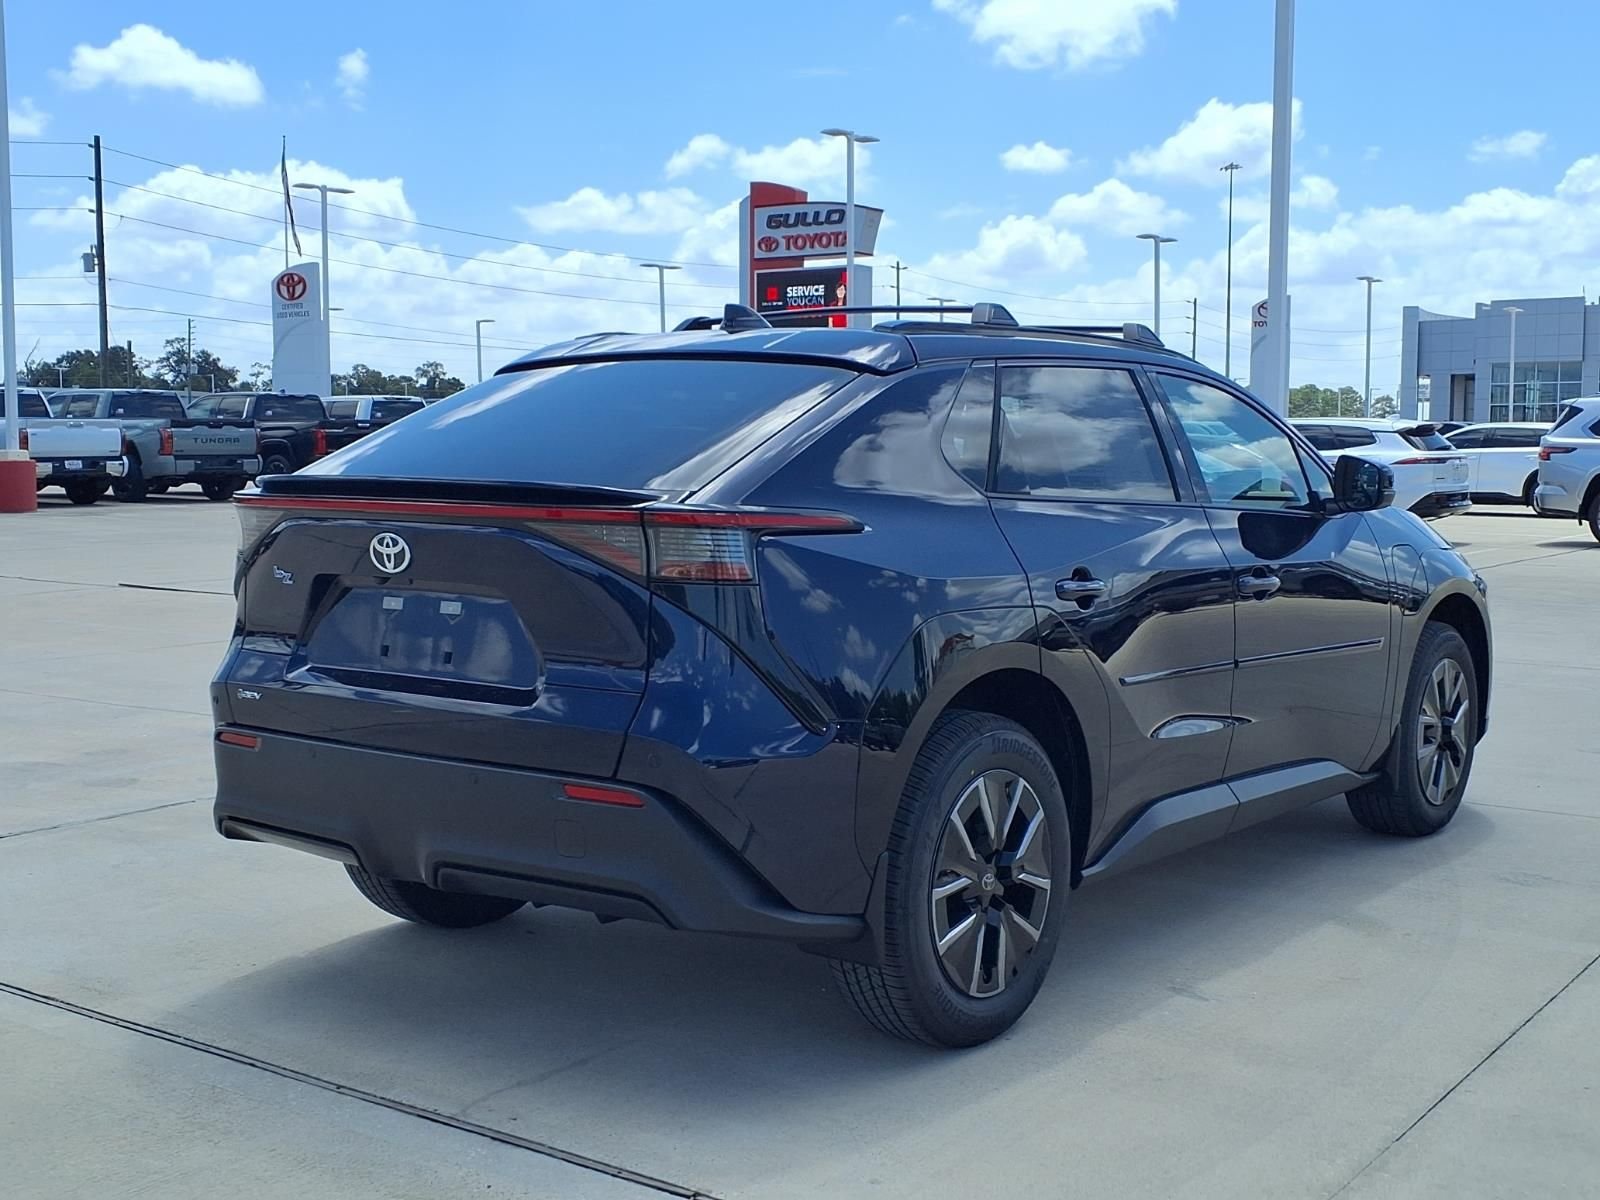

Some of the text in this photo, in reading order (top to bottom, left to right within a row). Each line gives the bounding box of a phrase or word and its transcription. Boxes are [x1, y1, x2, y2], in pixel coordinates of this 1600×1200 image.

[766, 209, 846, 229] GULLO
[786, 285, 825, 297] SERVICE
[786, 297, 805, 306] YOU
[805, 296, 825, 305] CAN
